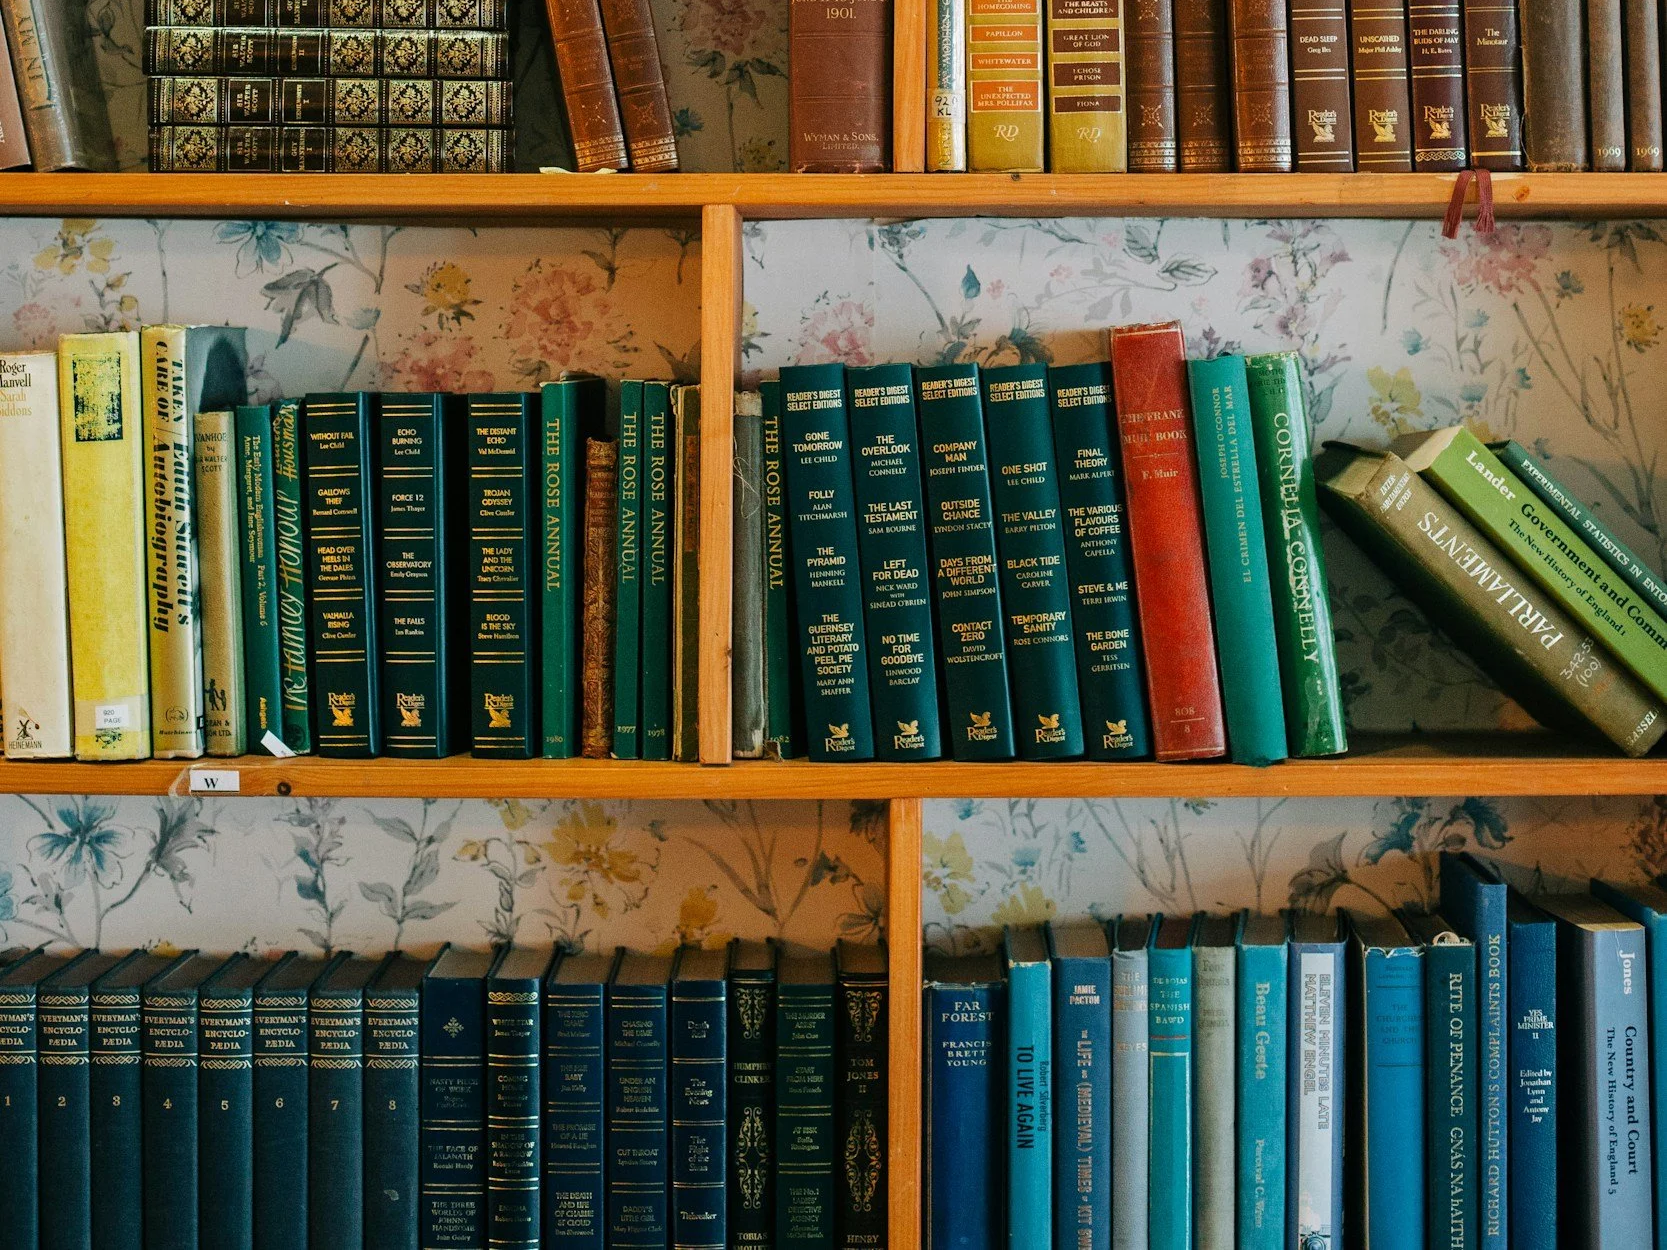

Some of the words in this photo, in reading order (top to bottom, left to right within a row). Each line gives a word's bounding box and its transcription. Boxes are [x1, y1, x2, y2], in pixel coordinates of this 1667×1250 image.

[826, 7, 857, 19] 1901.
[1319, 35, 1338, 43] SLEEP
[1597, 147, 1621, 157] 1969
[0, 360, 26, 376] Roger
[156, 341, 169, 388] CARE
[172, 359, 184, 424] TAKEN
[157, 392, 169, 424] OF
[546, 418, 559, 455] THE
[805, 432, 830, 442] GONE
[793, 440, 842, 453] TOMORROW
[933, 441, 977, 453] COMPANY
[945, 452, 967, 462] MAN
[1465, 450, 1516, 501] Lander
[546, 457, 560, 509] ROSE
[392, 494, 414, 502] FORCE
[416, 494, 424, 502] 12
[808, 490, 835, 500] FOLLY
[153, 435, 170, 633] Autobiography
[546, 514, 561, 592] ANNUAL
[1521, 503, 1601, 584] Government
[1599, 582, 1630, 609] and
[1007, 557, 1037, 569] BLACK
[1039, 555, 1061, 566] TIDE
[1417, 511, 1565, 650] PARLIAMENTS
[1508, 518, 1525, 539] The
[1524, 535, 1544, 556] New
[1543, 555, 1576, 589] History
[1576, 587, 1588, 597] of
[1587, 593, 1623, 633] England
[812, 633, 852, 643] LITERARY
[882, 634, 895, 643] NO
[897, 633, 920, 643] TIME
[807, 645, 826, 654] AND
[828, 643, 859, 653] POTATO
[881, 653, 924, 665] GOODBYE
[817, 664, 852, 675] SOCIETY
[8, 741, 42, 749] HEINEMANN
[203, 778, 218, 789] W
[1619, 949, 1634, 996] Jones
[1450, 972, 1463, 1013] RITE
[955, 1002, 980, 1011] FAR
[200, 1017, 251, 1027] EVERYMAN'S
[942, 1012, 994, 1022] FOREST
[1523, 1015, 1548, 1023] PRIME
[1450, 1017, 1463, 1040] OF
[1517, 1021, 1554, 1030] MINISTER
[205, 1029, 248, 1038] ENCYCLO-
[210, 1041, 241, 1050] PÆDIA
[943, 1040, 991, 1048] FRANCIS
[947, 1050, 987, 1058] BRETT
[1016, 1045, 1033, 1065] TO
[1624, 1025, 1637, 1092] Country
[947, 1059, 987, 1067] YOUNG
[1017, 1068, 1034, 1098] LIVE
[1450, 1042, 1464, 1117] PENANCE
[163, 1098, 172, 1109] 4
[220, 1100, 229, 1110] 5
[388, 1100, 397, 1110] 8
[1627, 1097, 1638, 1125] and
[1017, 1103, 1034, 1149] AGAIN
[1627, 1129, 1639, 1174] Court
